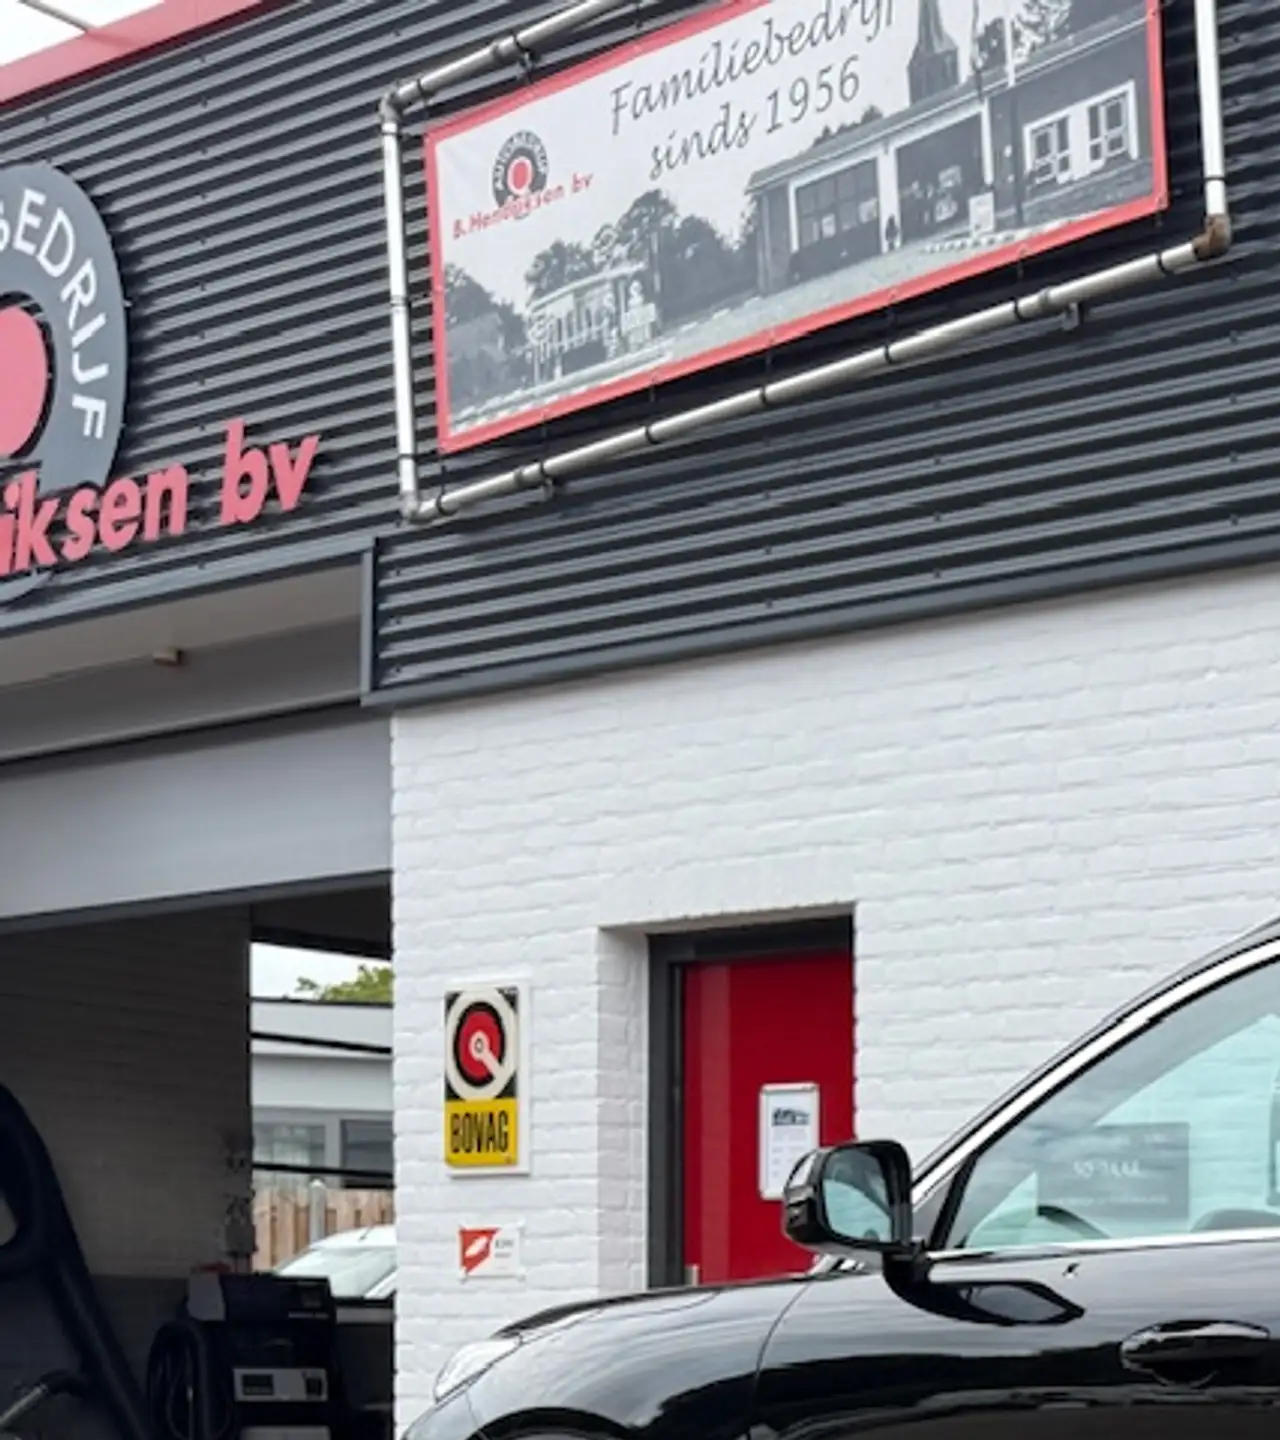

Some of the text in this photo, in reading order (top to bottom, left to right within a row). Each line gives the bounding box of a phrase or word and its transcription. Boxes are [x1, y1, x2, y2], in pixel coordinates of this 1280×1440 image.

[650, 54, 861, 181] sinds 1956
[220, 417, 320, 525] bv
[450, 1110, 509, 1154] BOVAG
